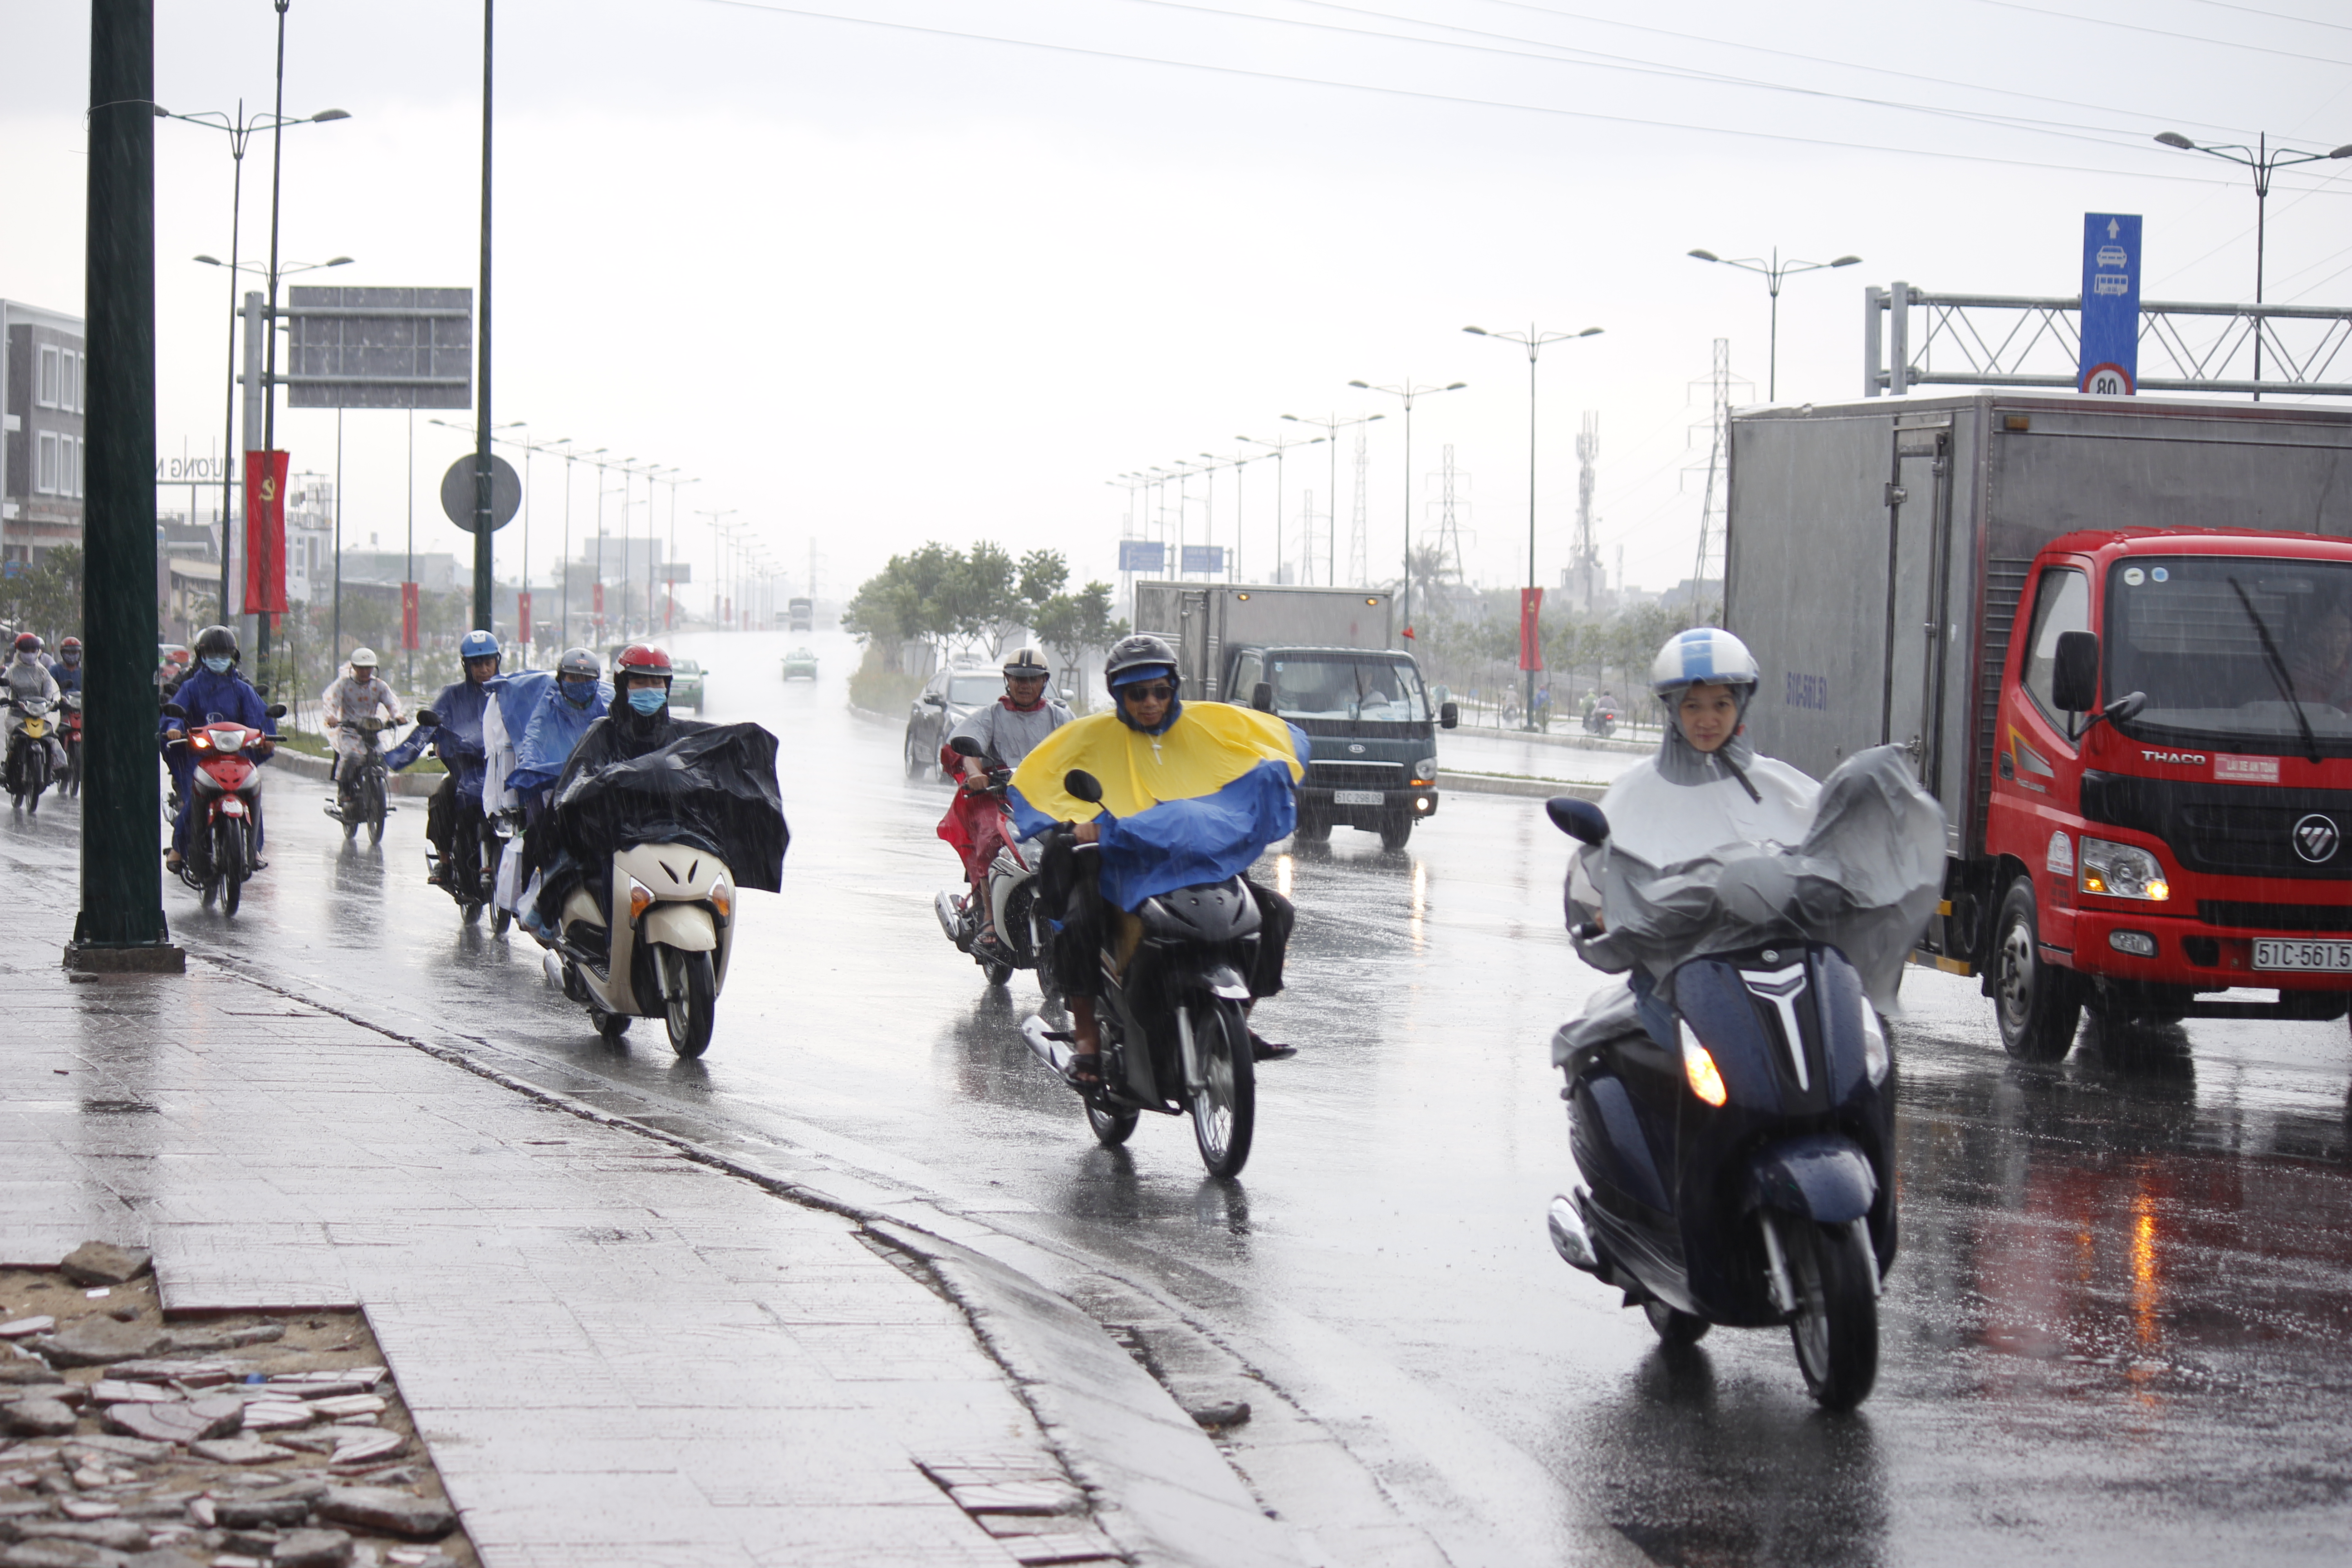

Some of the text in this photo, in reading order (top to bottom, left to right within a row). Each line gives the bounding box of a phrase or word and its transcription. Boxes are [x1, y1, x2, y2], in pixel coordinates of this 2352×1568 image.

[2097, 377, 2117, 394] 80
[2141, 750, 2206, 765] THACO
[2258, 943, 2351, 967] 51C-561.5
